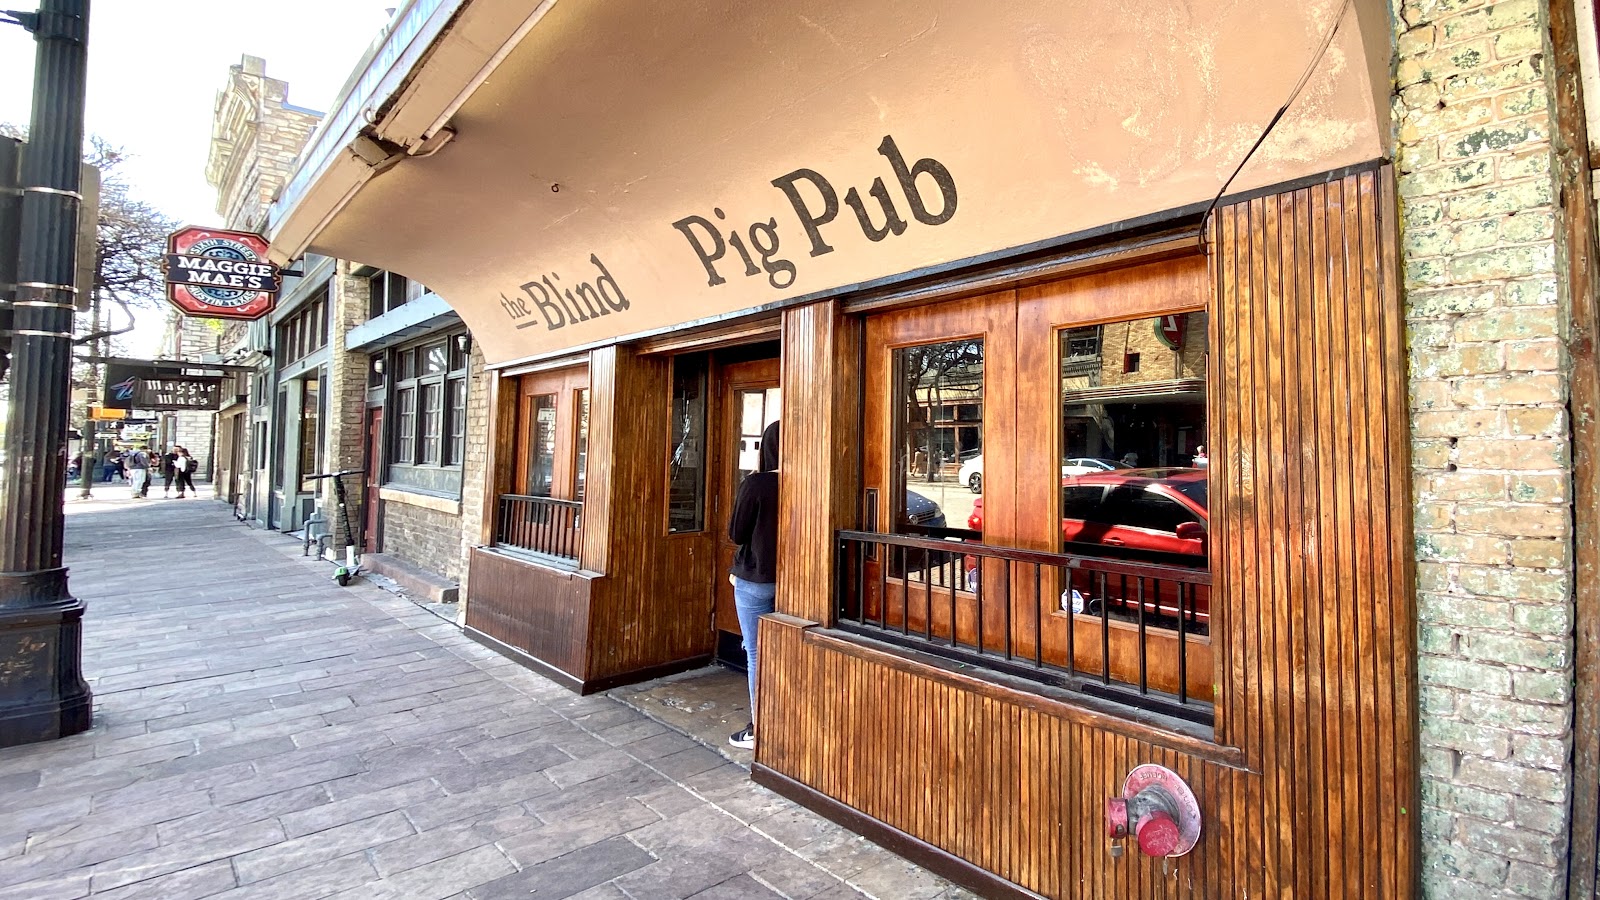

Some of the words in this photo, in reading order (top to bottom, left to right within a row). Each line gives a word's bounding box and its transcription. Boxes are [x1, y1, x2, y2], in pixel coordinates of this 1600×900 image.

[500, 291, 531, 320] the
[519, 252, 630, 332] Blind
[672, 206, 797, 289] Pig
[770, 134, 958, 258] Pub
[191, 239, 218, 254] SIXTH
[223, 240, 257, 261] STREET
[178, 256, 272, 277] MAGGIE
[187, 270, 262, 289] MAE'S
[189, 286, 224, 306] AUSTIN
[144, 379, 216, 395] Maggie
